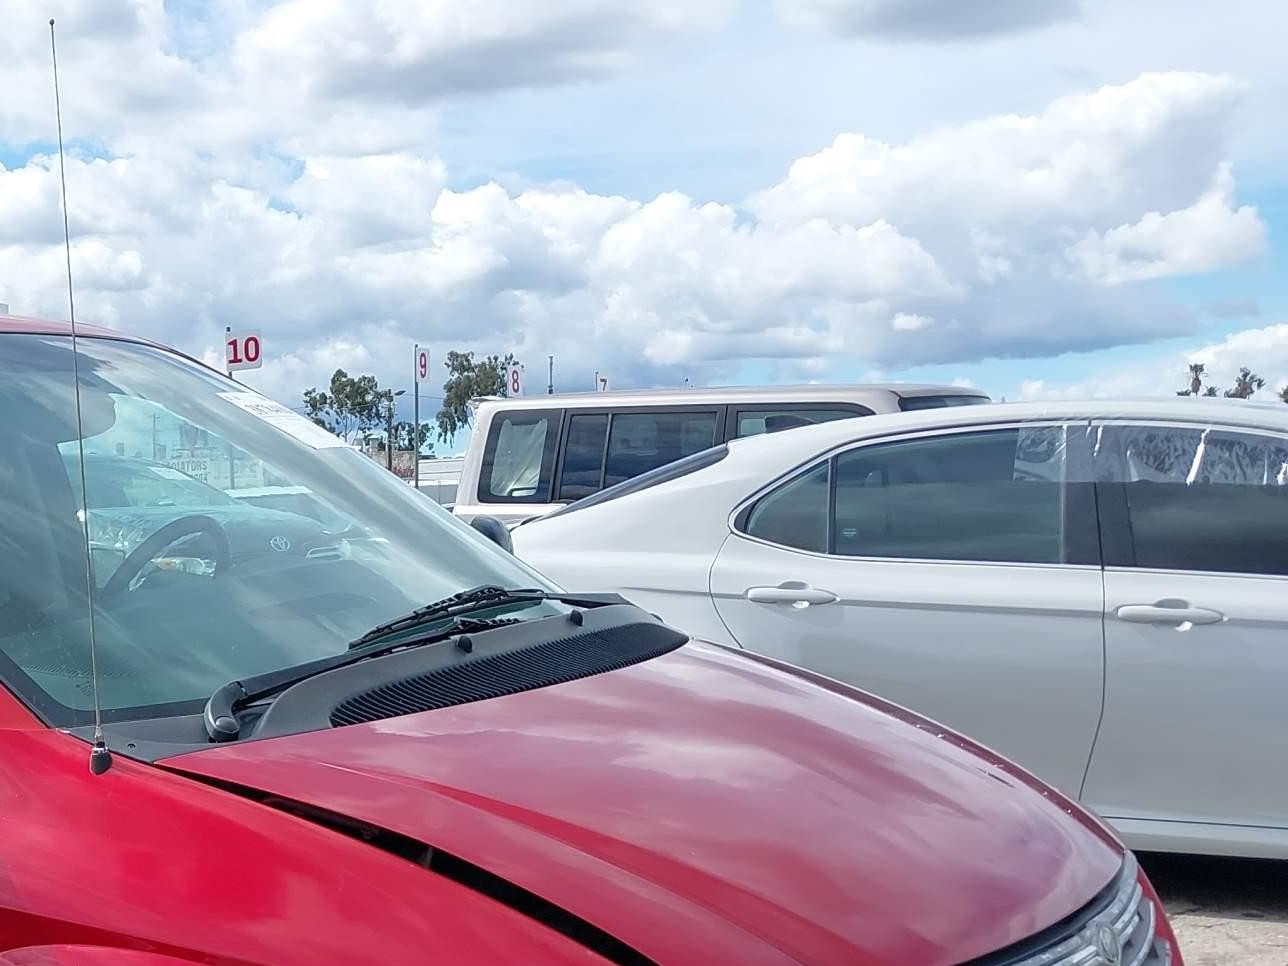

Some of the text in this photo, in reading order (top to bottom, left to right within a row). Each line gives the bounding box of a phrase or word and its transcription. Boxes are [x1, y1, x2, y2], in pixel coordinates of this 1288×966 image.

[227, 336, 260, 364] 10
[419, 352, 428, 378] 9
[511, 369, 521, 393] 8
[599, 378, 608, 392] 7
